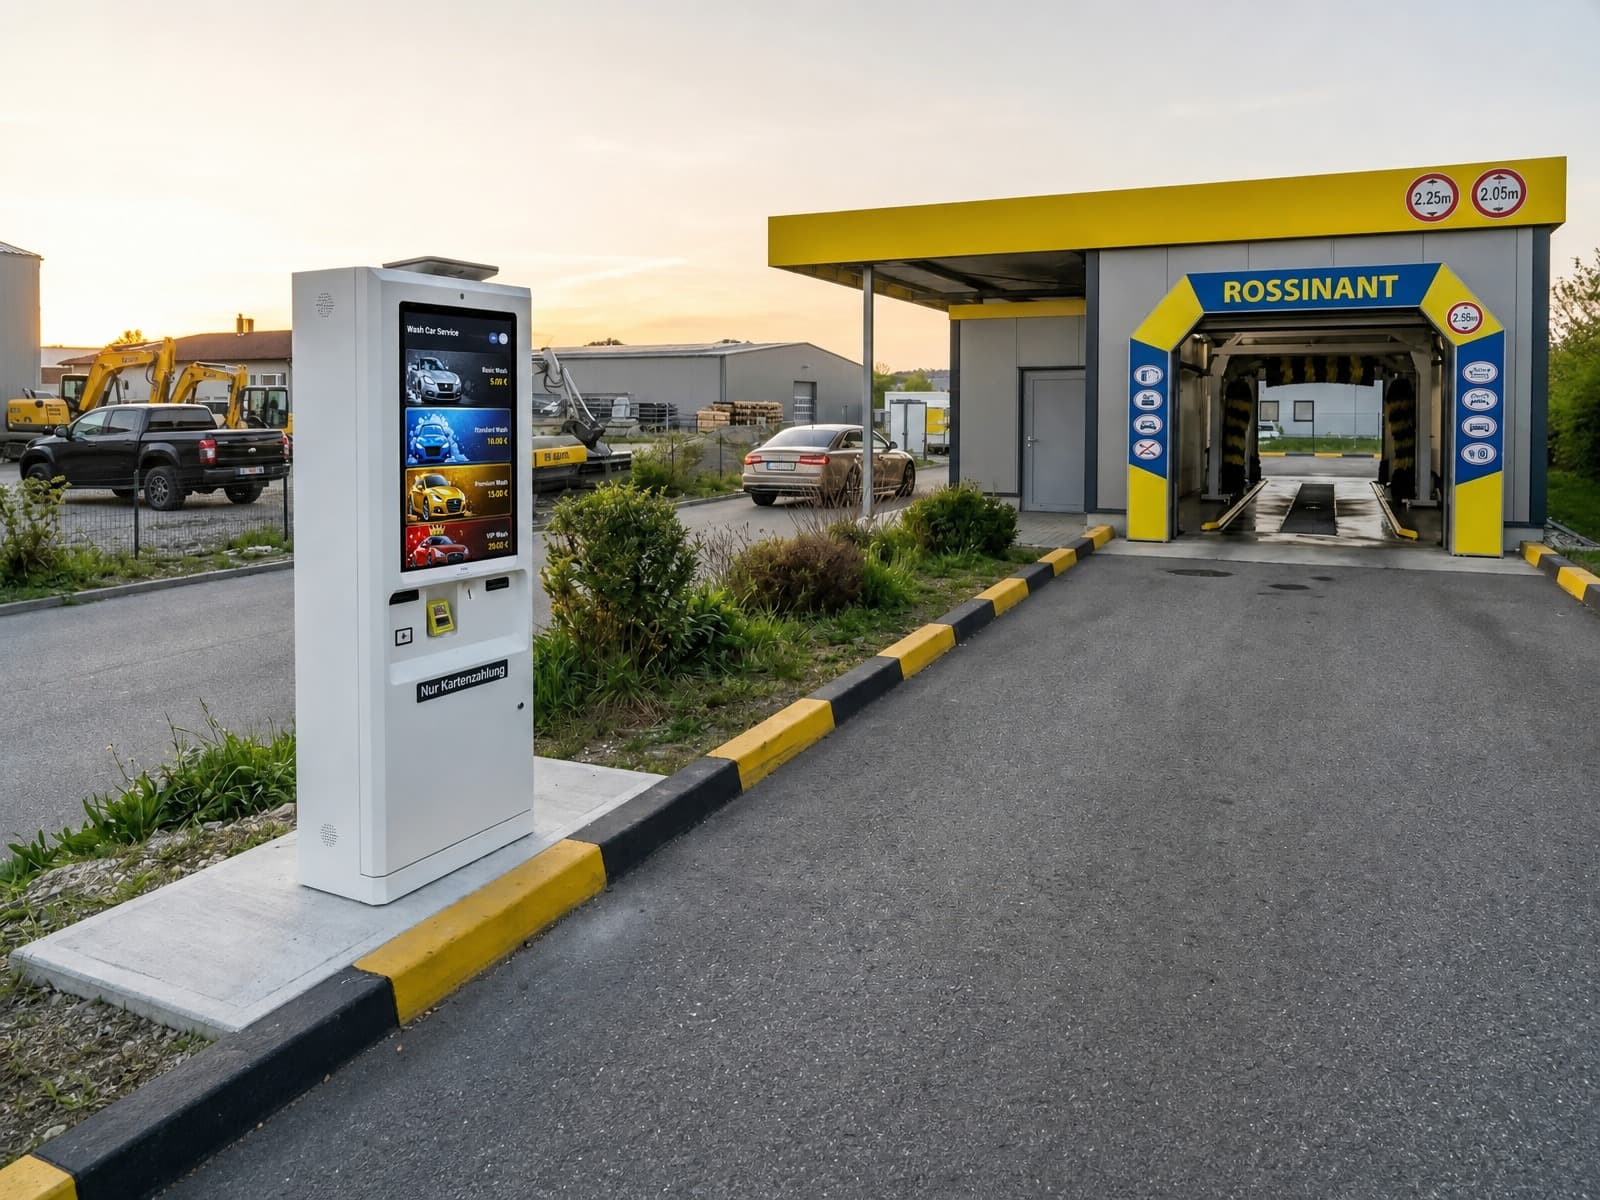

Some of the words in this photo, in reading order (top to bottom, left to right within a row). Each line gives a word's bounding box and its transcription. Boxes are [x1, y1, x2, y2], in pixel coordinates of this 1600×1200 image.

[1414, 191, 1452, 206] 2.25m
[1480, 186, 1519, 201] 2.05m
[1223, 275, 1399, 303] ROSSINANT
[406, 324, 424, 334] Wash
[425, 326, 436, 335] Car
[437, 327, 459, 337] Service
[420, 684, 439, 697] Nur
[441, 665, 506, 691] Kartenzahlung
